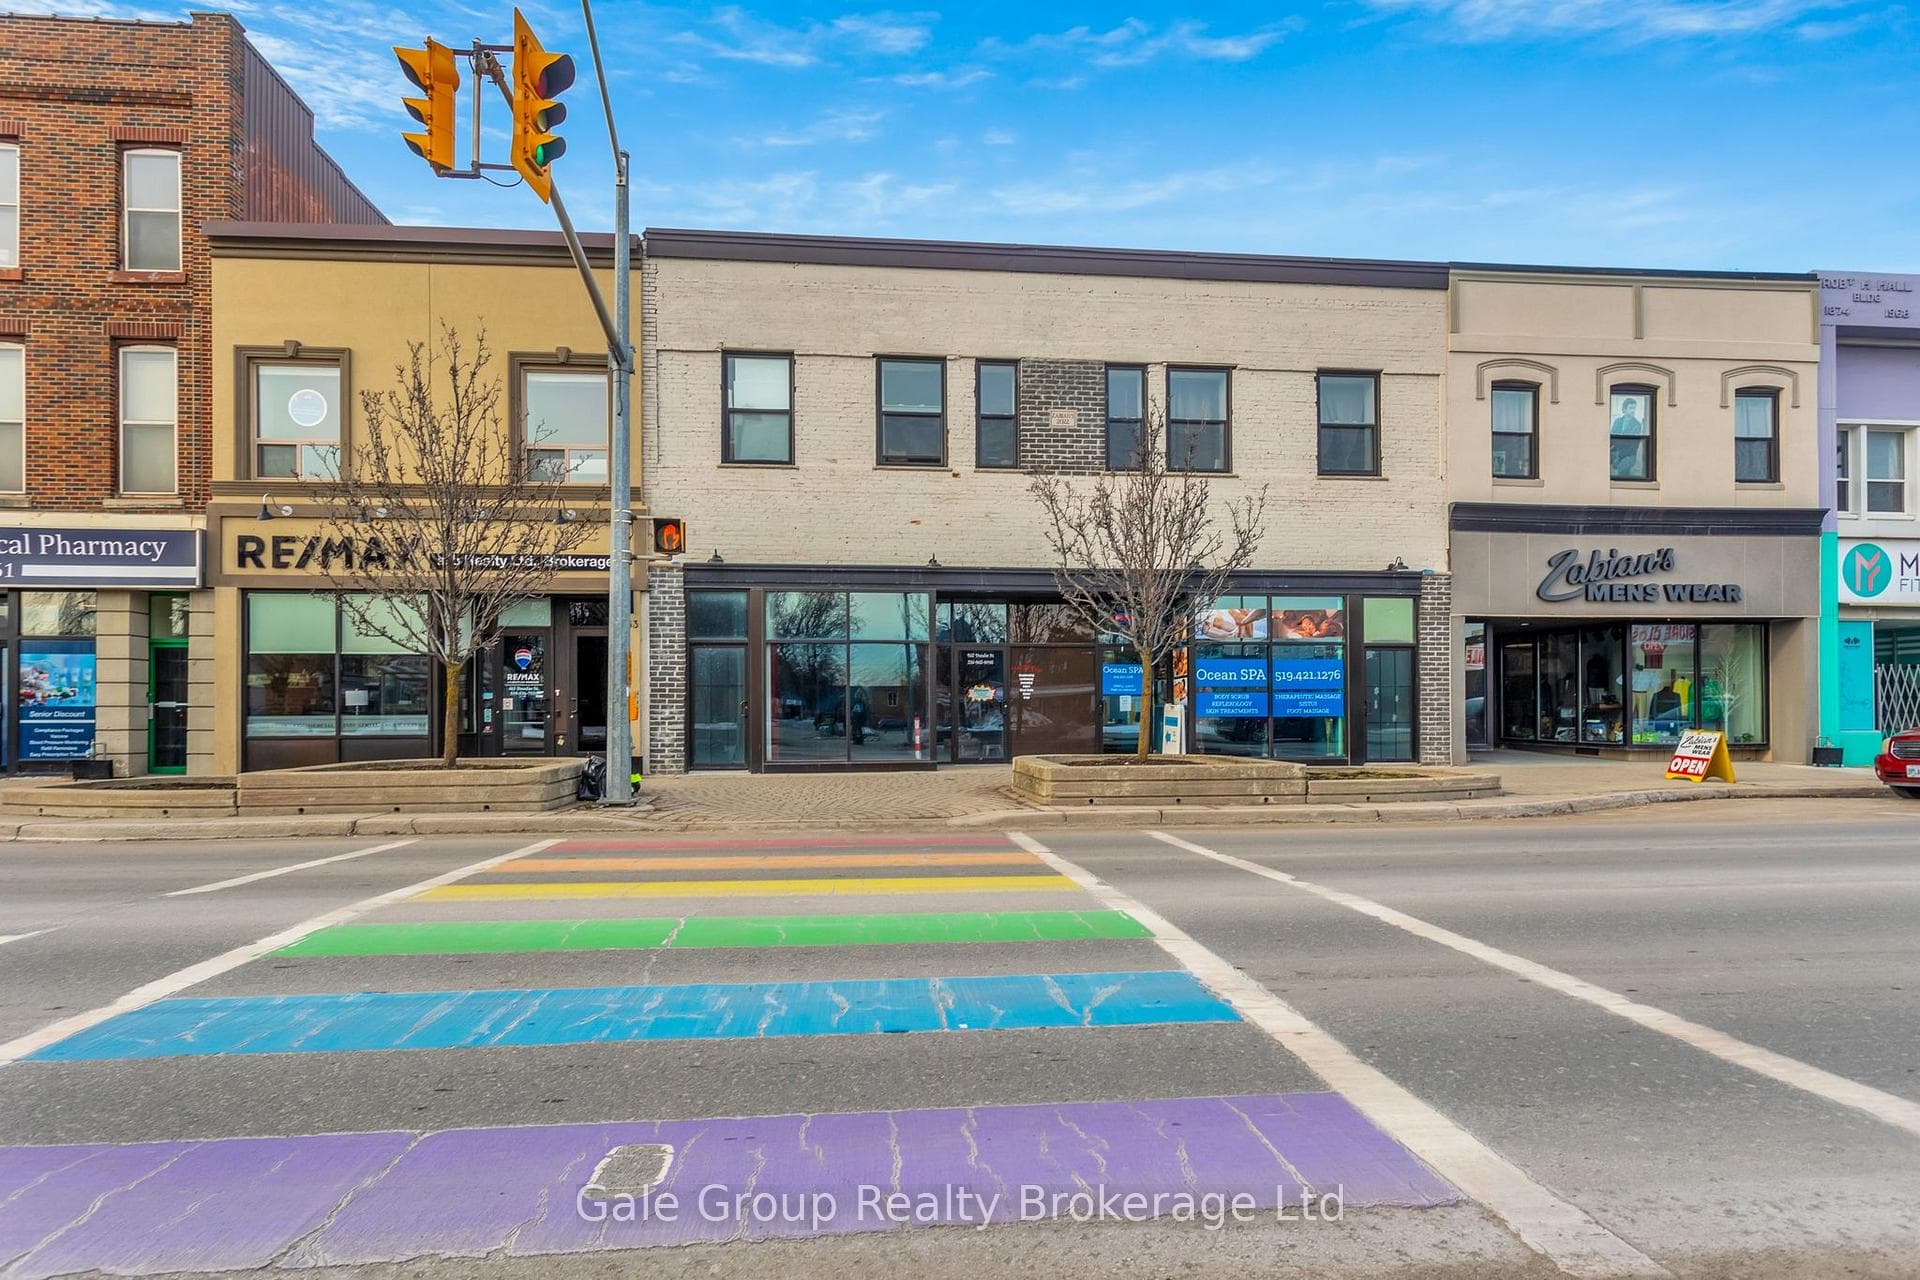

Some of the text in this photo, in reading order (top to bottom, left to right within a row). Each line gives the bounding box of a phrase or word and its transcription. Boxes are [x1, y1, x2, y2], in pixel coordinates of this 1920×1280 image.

[1876, 281, 1913, 293] HALL
[1852, 293, 1882, 304] BLDG
[1823, 305, 1850, 317] 1874
[38, 534, 168, 562] Pharmacy
[236, 535, 422, 570] RE/MAX
[545, 555, 612, 569] Brokerage
[1537, 548, 1675, 602] Zabian's
[1585, 583, 1742, 603] MENS WEAR
[1103, 666, 1144, 674] Ocean SPA
[1196, 669, 1267, 681] Ocean SPA
[1275, 670, 1341, 681] 519.421.1276
[507, 673, 540, 681] RE/MAX
[29, 710, 53, 718] Senior
[1670, 758, 1708, 774] OPEN
